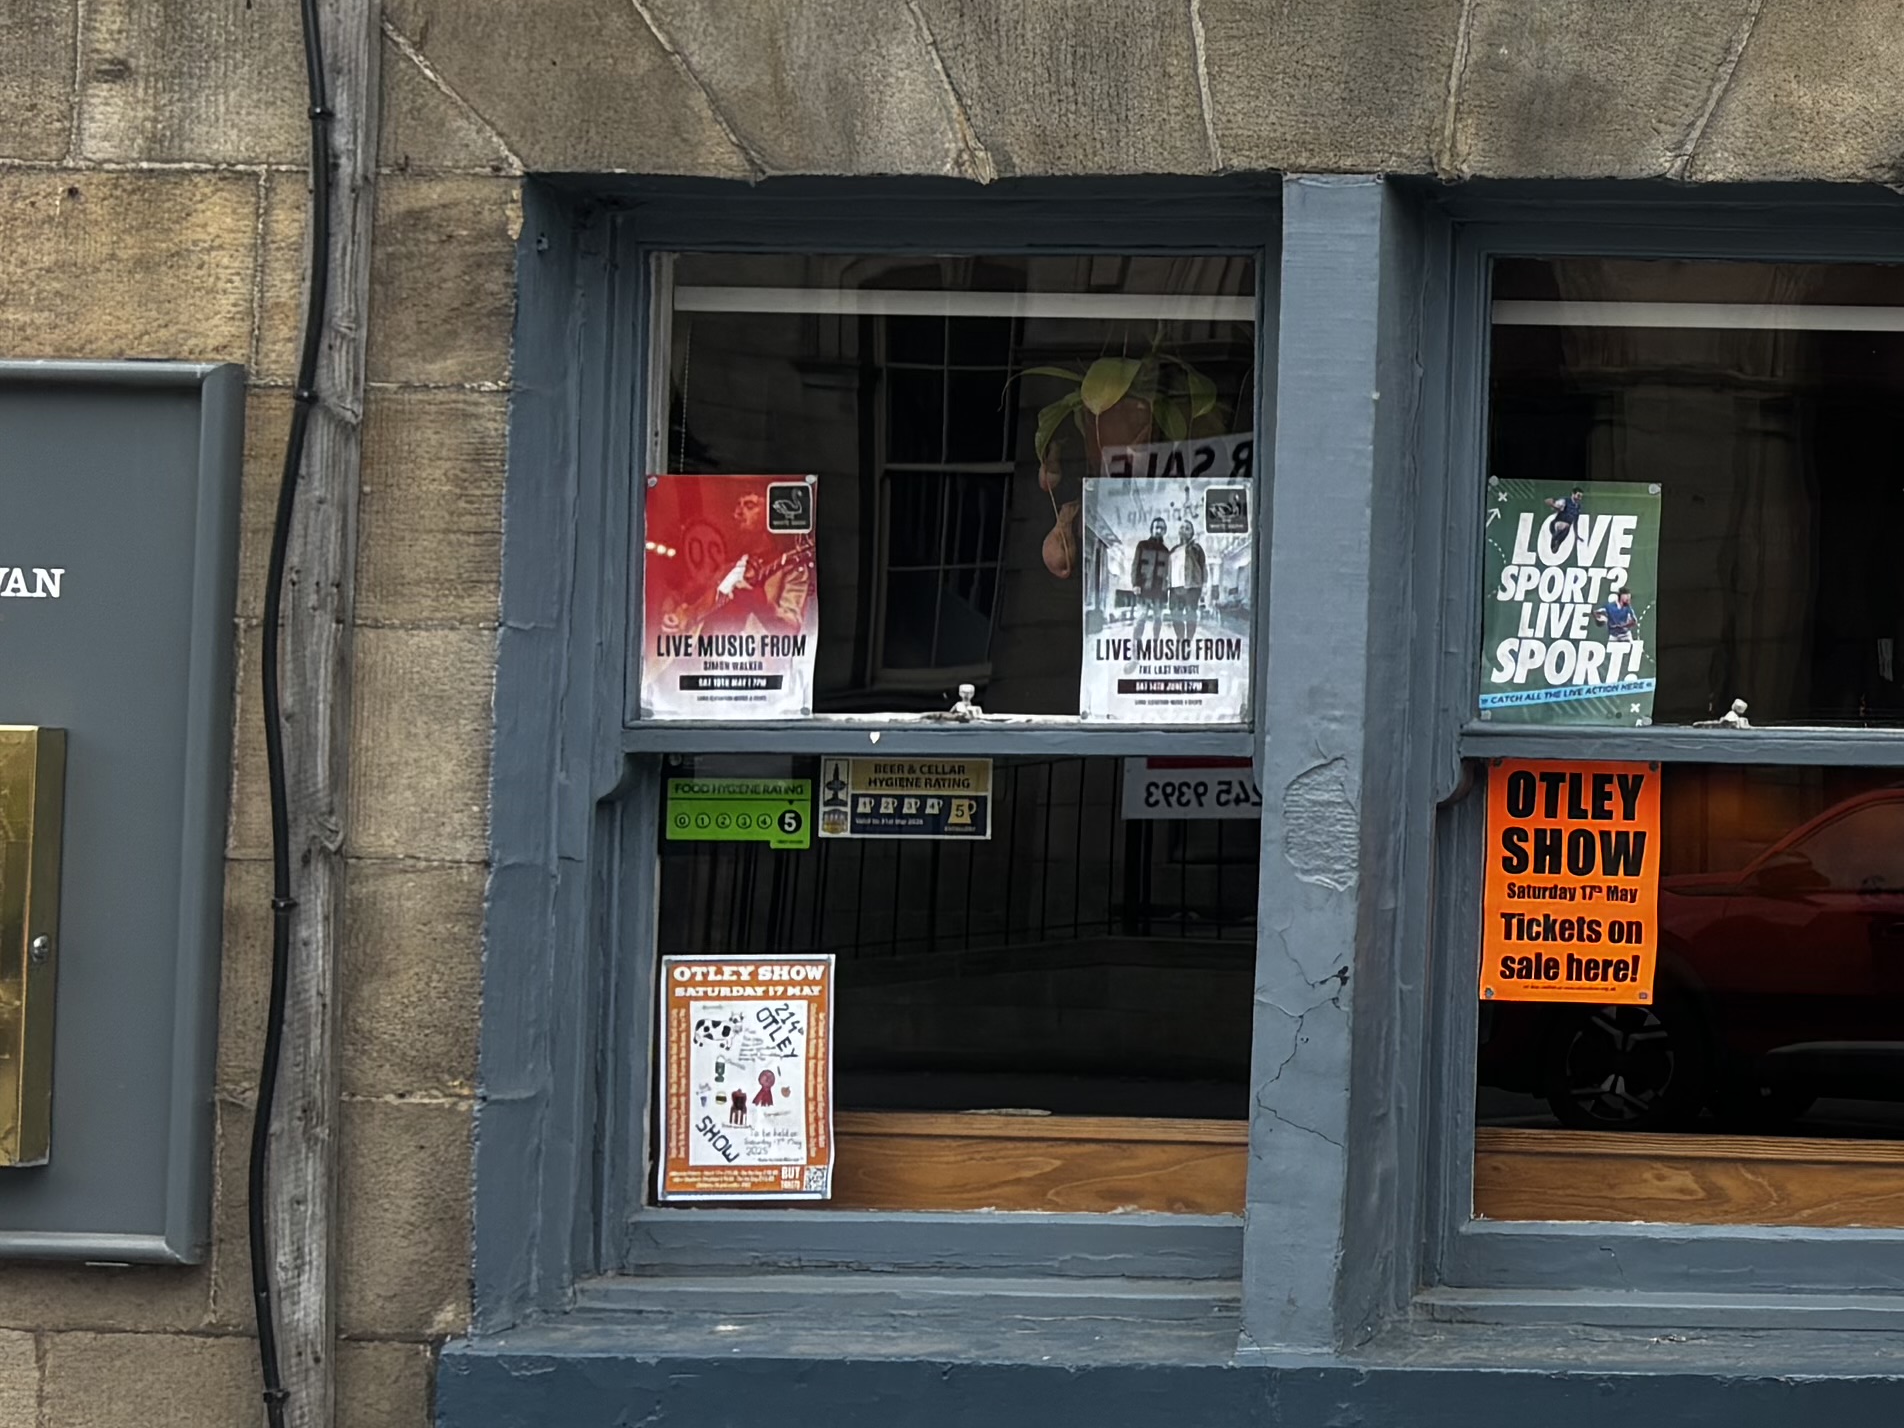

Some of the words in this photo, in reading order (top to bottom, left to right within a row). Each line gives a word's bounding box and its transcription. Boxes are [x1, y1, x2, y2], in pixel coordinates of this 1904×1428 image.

[1511, 512, 1638, 568] LOVE
[0, 567, 66, 599] AN
[1496, 565, 1628, 604] SPORT?
[1517, 602, 1593, 640] LIVE
[656, 634, 693, 658] LIVE
[698, 634, 756, 657] MUSIC
[761, 634, 807, 657] FROM
[1096, 638, 1132, 661] LIVE
[1136, 638, 1193, 661] MUSIC
[1196, 638, 1242, 661] FROM
[1490, 637, 1644, 686] SPORT!
[1490, 693, 1523, 704] CATCH
[1524, 691, 1543, 702] ALL
[1544, 689, 1562, 700] THE
[1563, 687, 1584, 698] LIVE
[1585, 684, 1620, 696] ACTION
[1621, 681, 1644, 692] HERE
[868, 777, 921, 788] HYGIENE
[924, 777, 970, 789] RATING
[874, 764, 905, 774] BEER
[907, 764, 916, 775] &
[919, 764, 965, 775] CELLAR
[674, 783, 710, 794] FOOD
[711, 784, 761, 795] HYGIENE
[763, 784, 804, 795] RATING
[1506, 770, 1645, 821] OTLEY
[783, 813, 797, 831] 5
[955, 804, 965, 818] 5
[1501, 826, 1647, 877] SHOW
[1507, 882, 1577, 902] Saturday
[1606, 885, 1638, 904] May
[1500, 912, 1602, 944] Tickets
[1608, 920, 1643, 945] on
[673, 965, 756, 982] OTLEY
[757, 965, 825, 981] SHOW
[1500, 952, 1560, 982] sale
[1566, 952, 1641, 983] here!
[674, 986, 767, 997] SATURDAY
[769, 986, 782, 996] 17
[787, 986, 823, 997] MAY
[756, 1006, 799, 1059] OTLEY
[694, 1115, 741, 1164] SHOW
